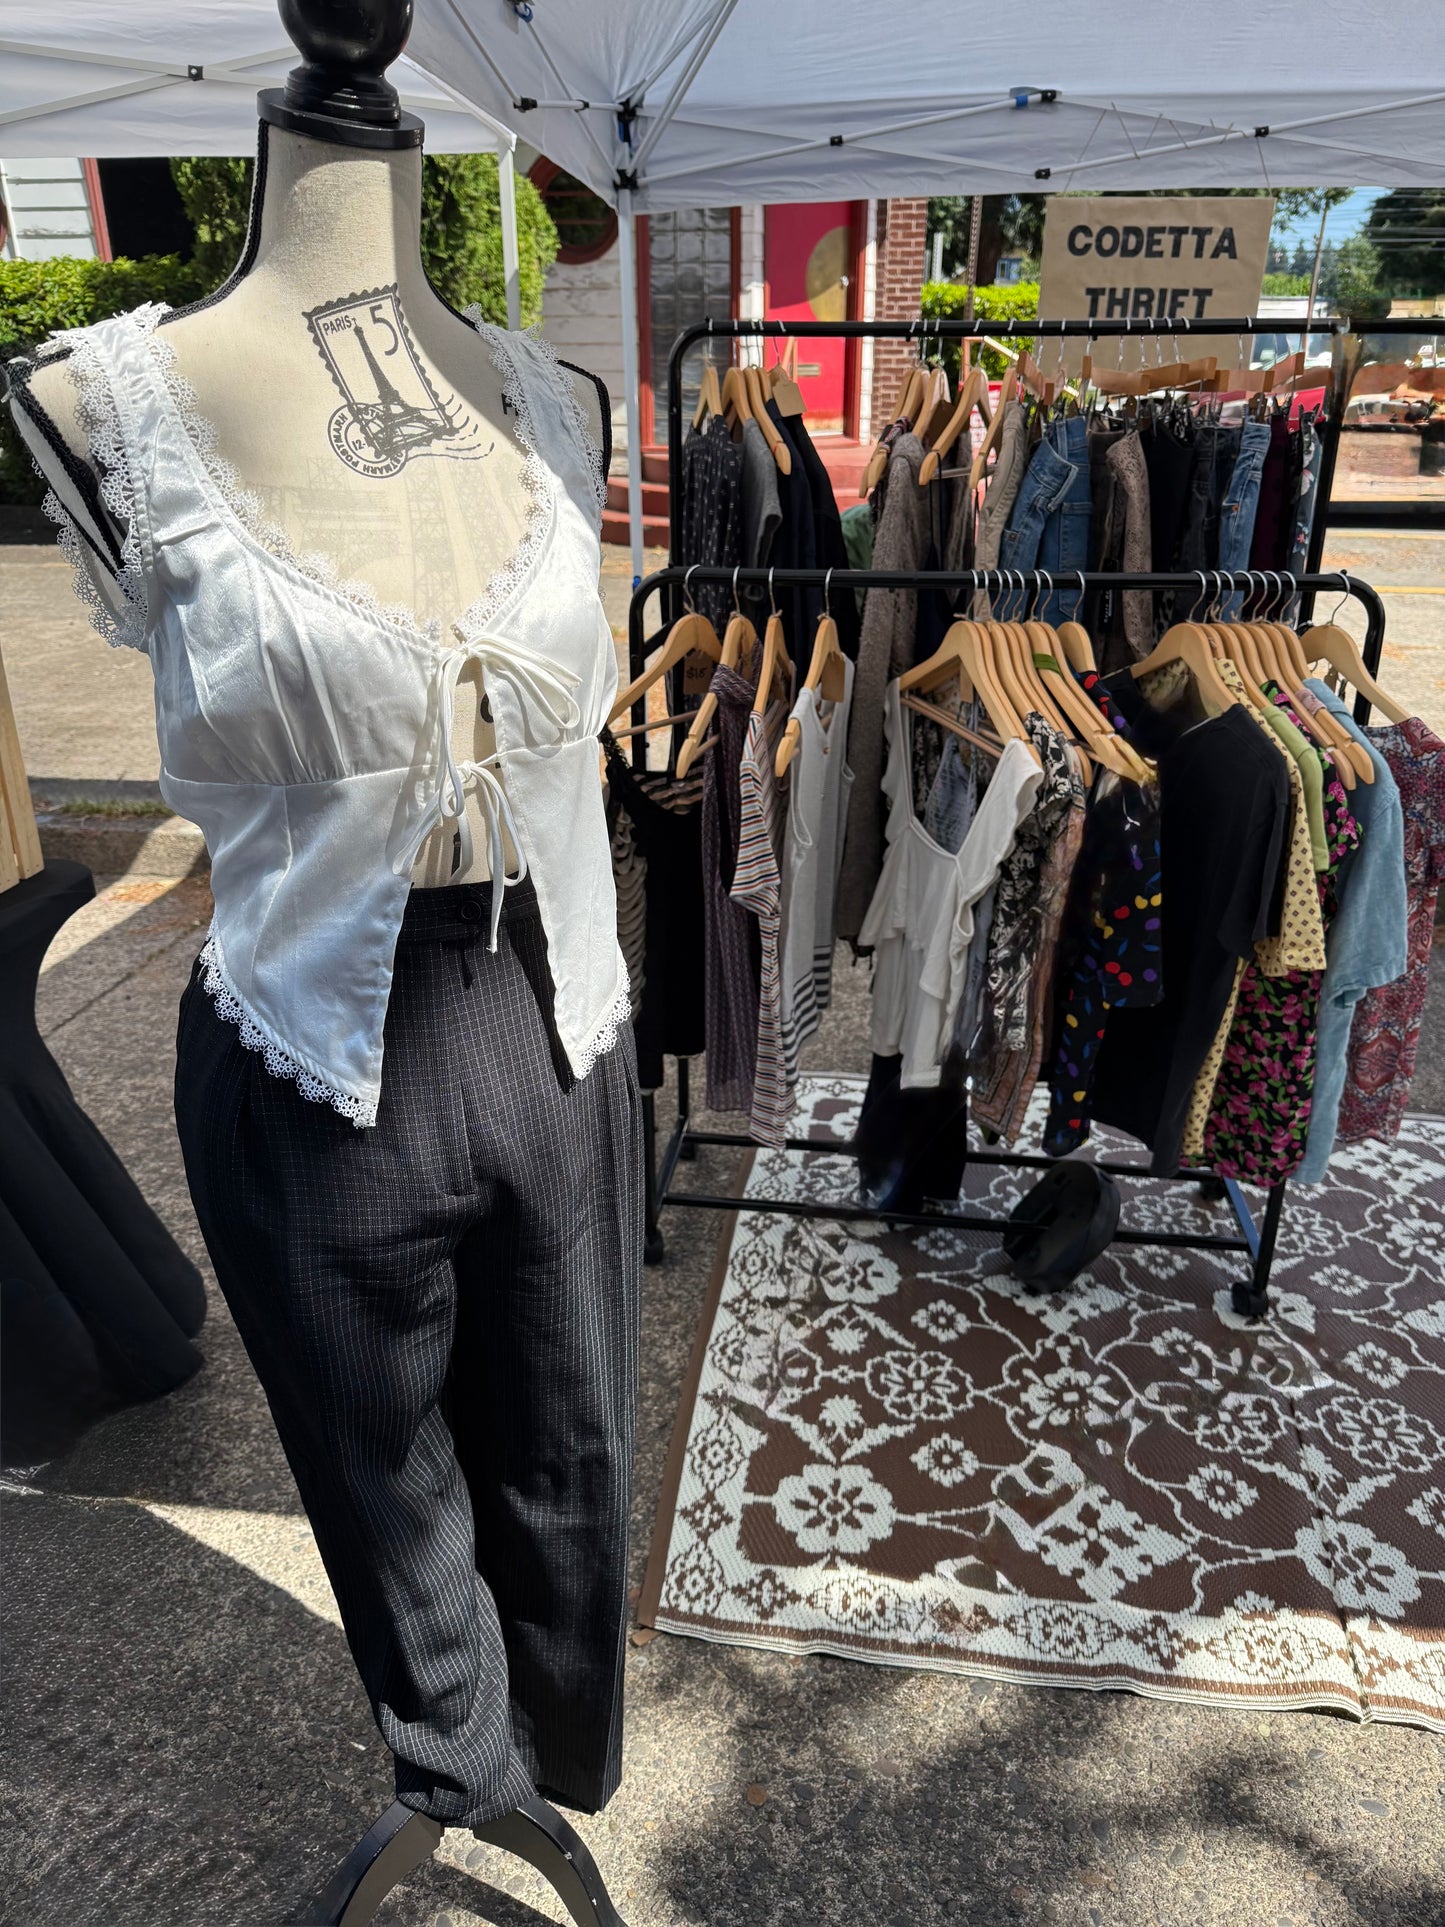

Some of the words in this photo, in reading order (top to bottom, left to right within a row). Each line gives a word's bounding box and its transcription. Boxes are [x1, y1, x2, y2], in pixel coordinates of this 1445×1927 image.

[1067, 225, 1237, 259] CODETTA
[1085, 287, 1213, 318] THRIFT
[322, 315, 352, 336] PARIS
[369, 304, 399, 356] 5
